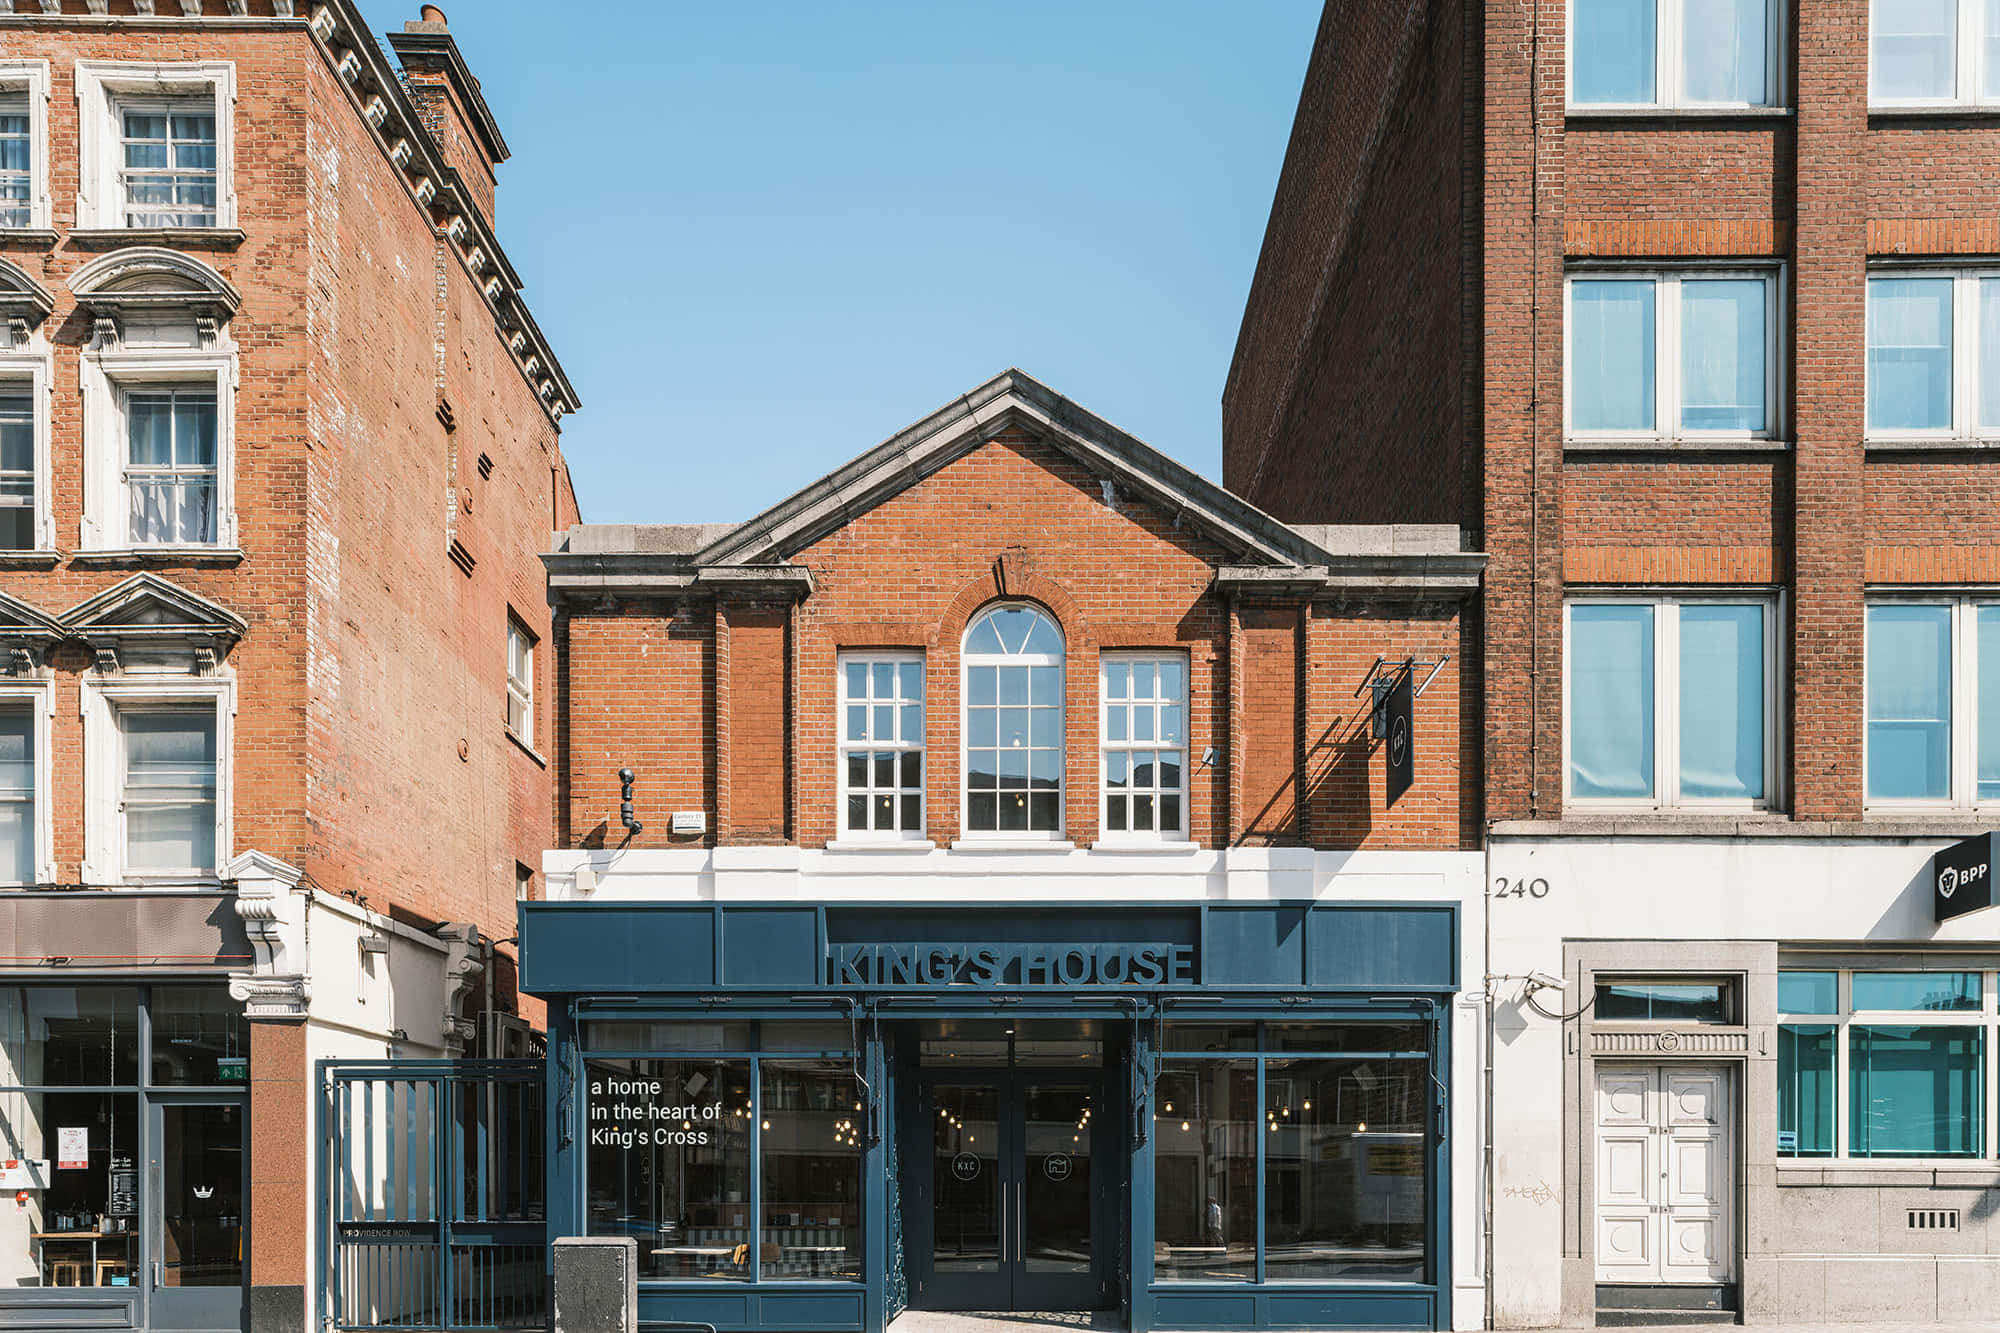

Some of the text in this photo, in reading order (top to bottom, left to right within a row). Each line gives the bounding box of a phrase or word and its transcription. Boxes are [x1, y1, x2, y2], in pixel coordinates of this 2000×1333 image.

[1960, 863, 1988, 885] BPP
[1494, 877, 1549, 898] 240
[832, 944, 1194, 985] KING'S HOUSE
[591, 1077, 661, 1095] a home
[591, 1101, 722, 1120] in the heart of
[591, 1127, 708, 1150] King's Cross
[957, 1160, 976, 1171] KXC
[343, 1229, 392, 1238] PROVIDENCE
